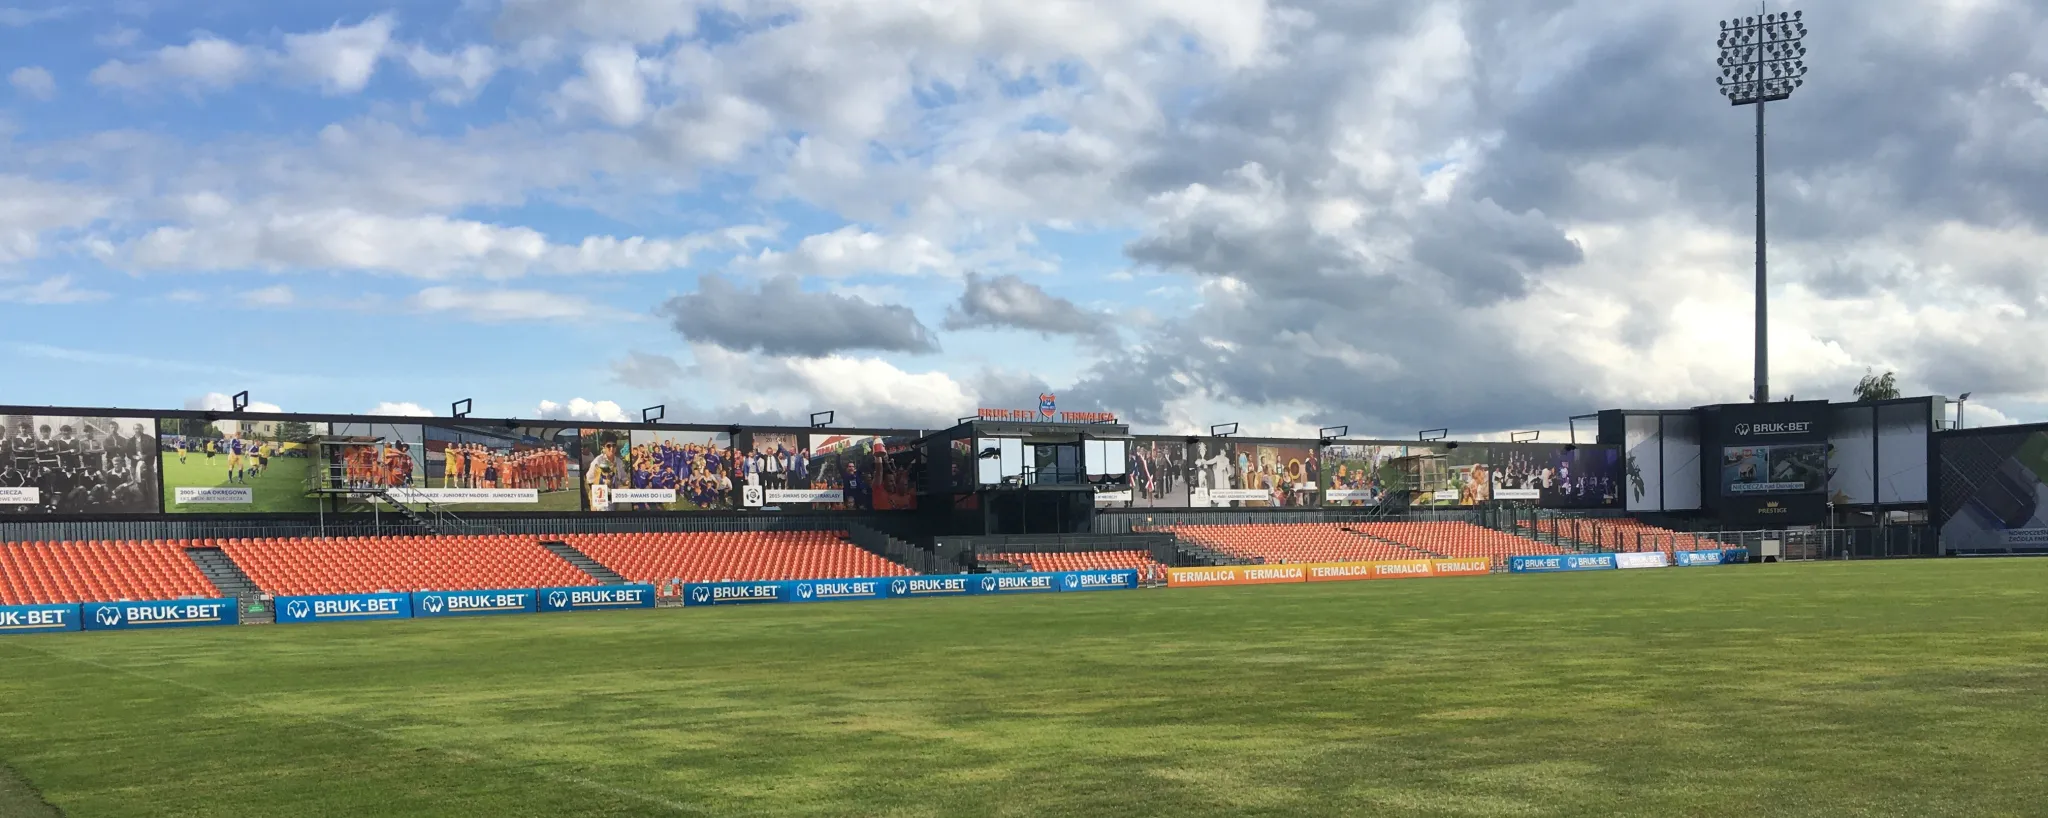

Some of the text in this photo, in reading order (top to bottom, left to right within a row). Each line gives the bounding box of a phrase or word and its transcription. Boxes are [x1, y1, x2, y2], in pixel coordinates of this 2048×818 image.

[978, 408, 1115, 421] BRUK-BET TERMALICA
[1753, 422, 1810, 433] BRUK-BET
[1525, 558, 1561, 568] BRUK-BET
[1578, 556, 1611, 566] BRUK-BET
[1690, 553, 1720, 562] BRUK-BET
[1311, 565, 1367, 577] TERMALICA
[1375, 563, 1429, 575] TERMALICA
[1436, 561, 1486, 572] TERMALICA
[1081, 573, 1129, 585] BRUK-BET
[1172, 569, 1235, 583] TERMALICA
[1244, 567, 1303, 580] TERMALICA
[816, 582, 876, 595] BRUK-BET
[909, 578, 966, 591] BRUK-BET
[999, 576, 1051, 588] BRUK-BET
[572, 589, 643, 603] BRUK-BET
[713, 585, 778, 599] BRUK-BET
[315, 598, 400, 614] BRUK-BET
[448, 593, 525, 609] BRUK-BET
[127, 603, 221, 621] BRUK-BET
